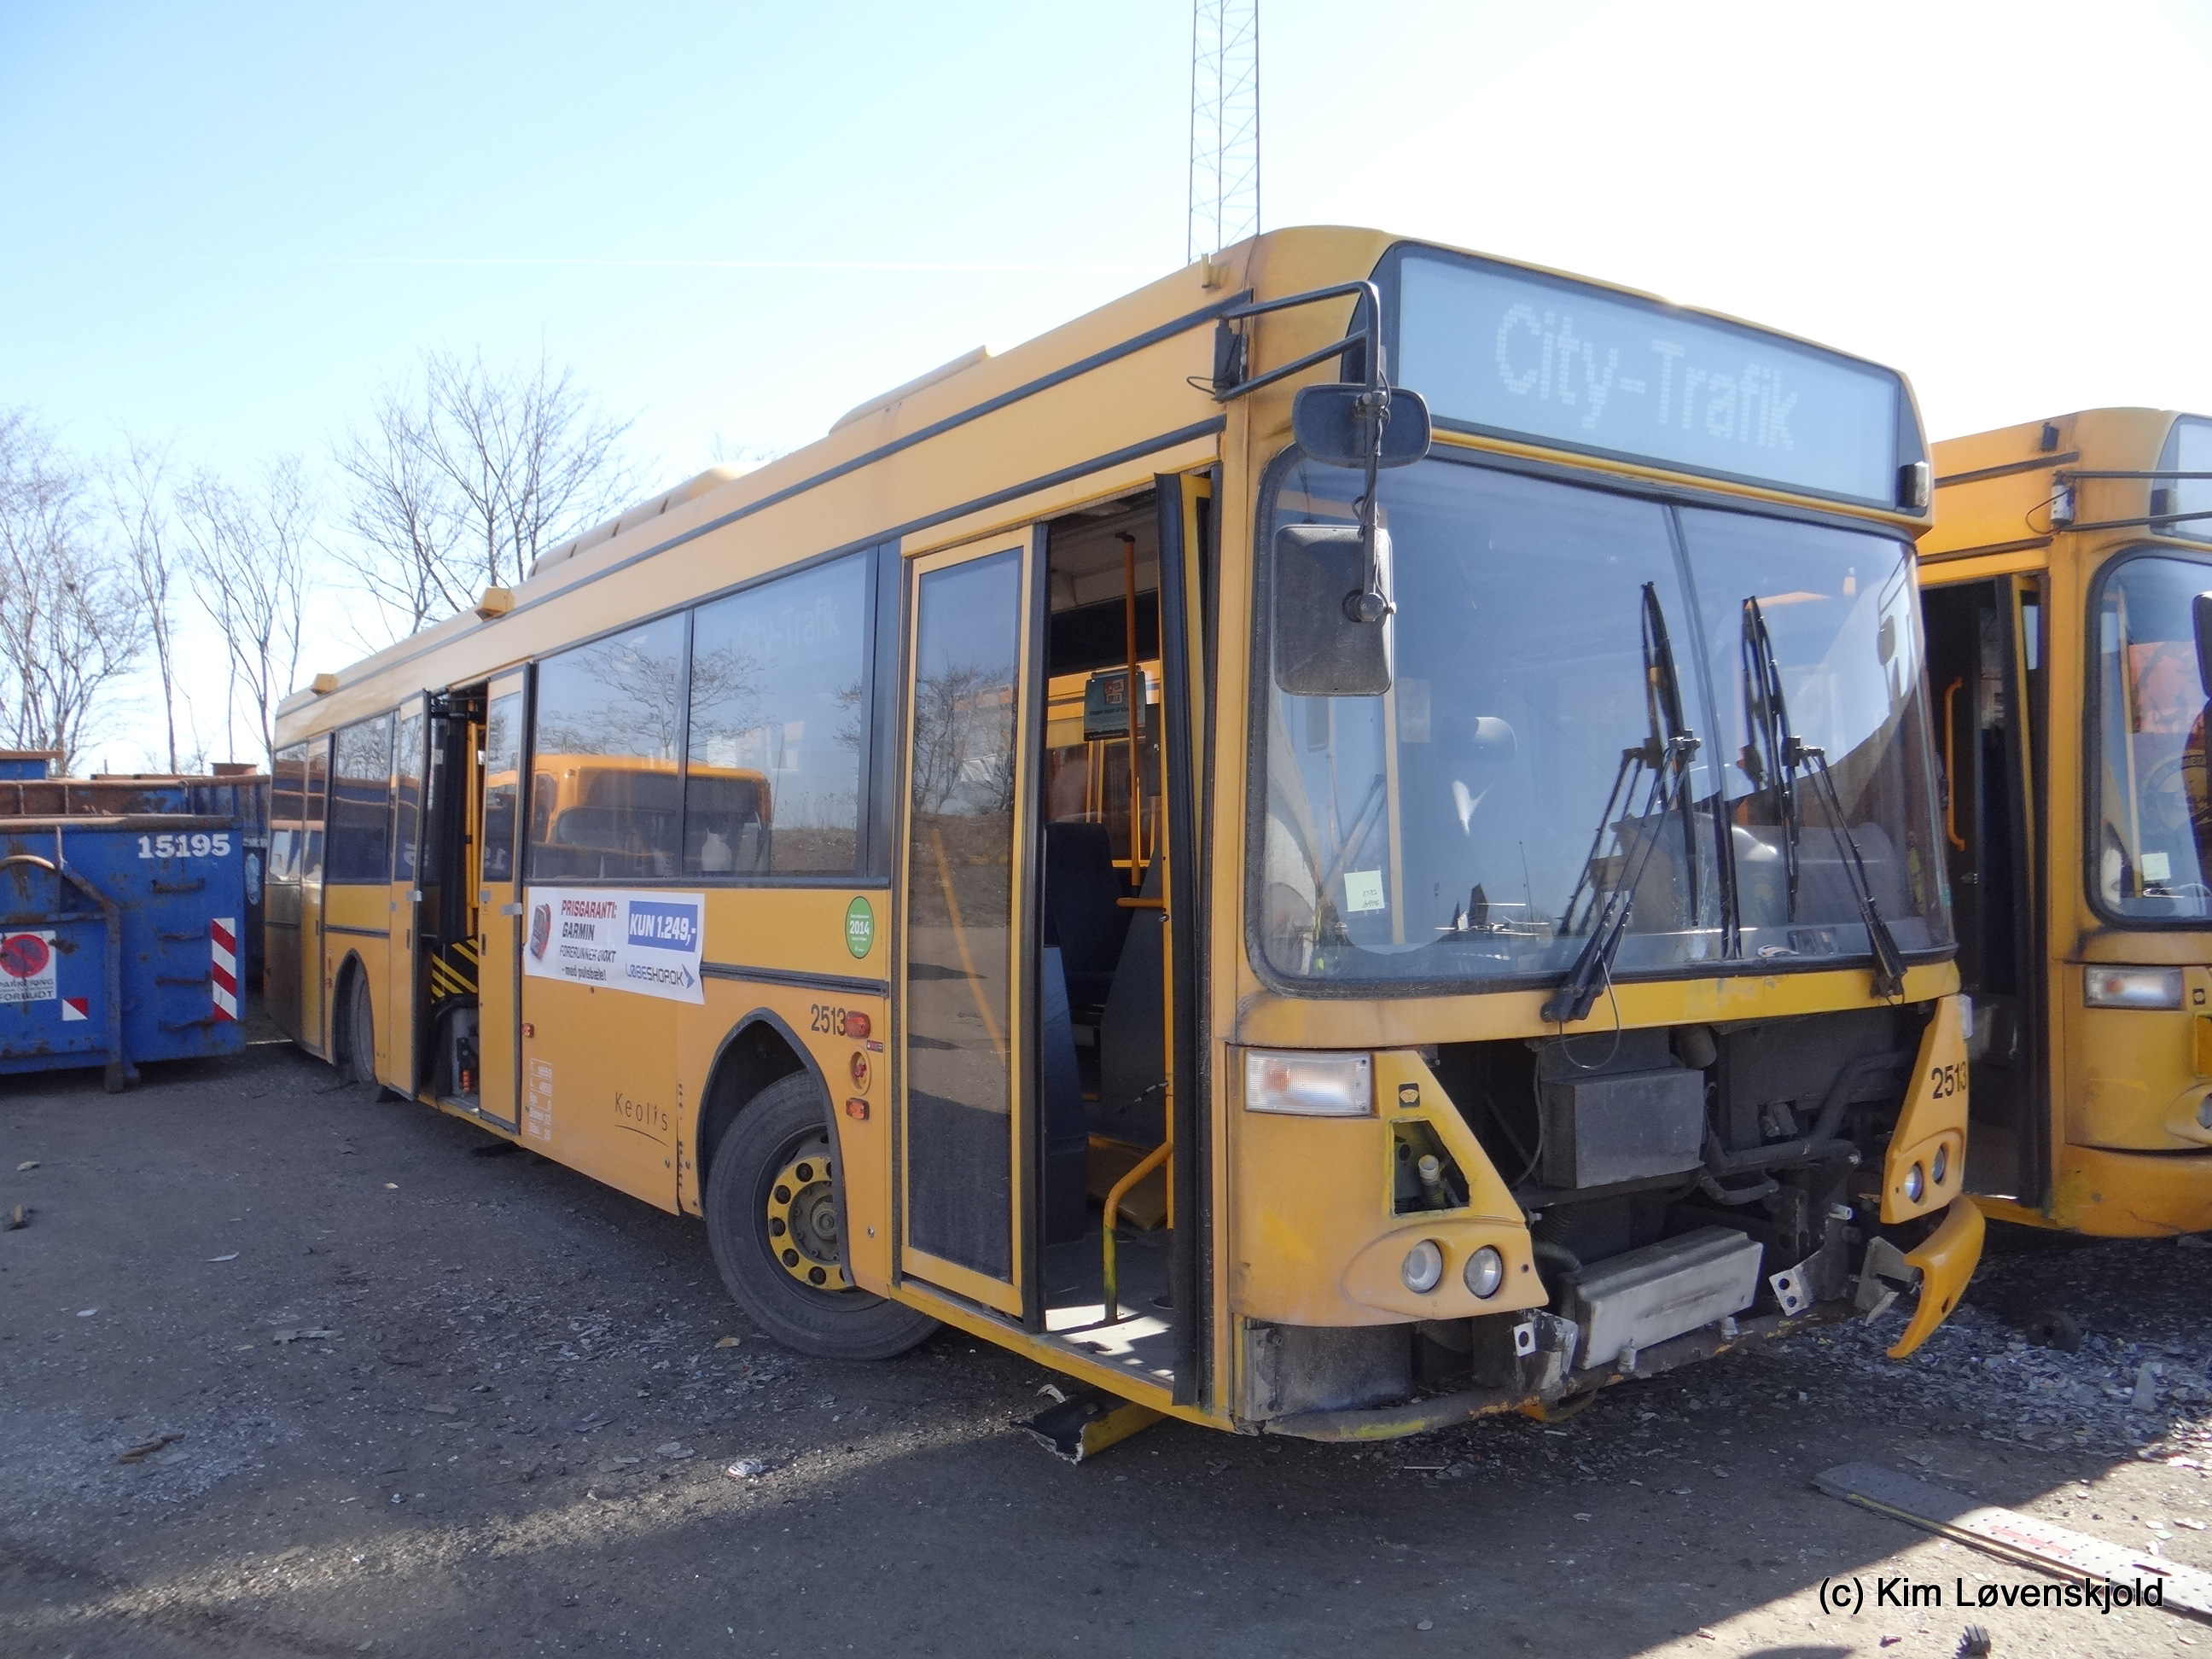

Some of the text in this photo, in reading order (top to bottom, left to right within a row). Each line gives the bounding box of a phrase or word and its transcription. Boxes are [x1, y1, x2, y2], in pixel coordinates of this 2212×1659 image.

[1495, 302, 1799, 452] City-Trafik
[138, 834, 231, 859] 15195
[561, 899, 617, 919] PRISGARANTI:
[562, 923, 596, 941] GARMIN
[629, 913, 696, 946] KUN 1.249,-
[849, 920, 870, 935] 2014
[811, 1004, 847, 1036] 2513
[1931, 1061, 1967, 1100] 2513
[614, 1091, 669, 1132] Keolis
